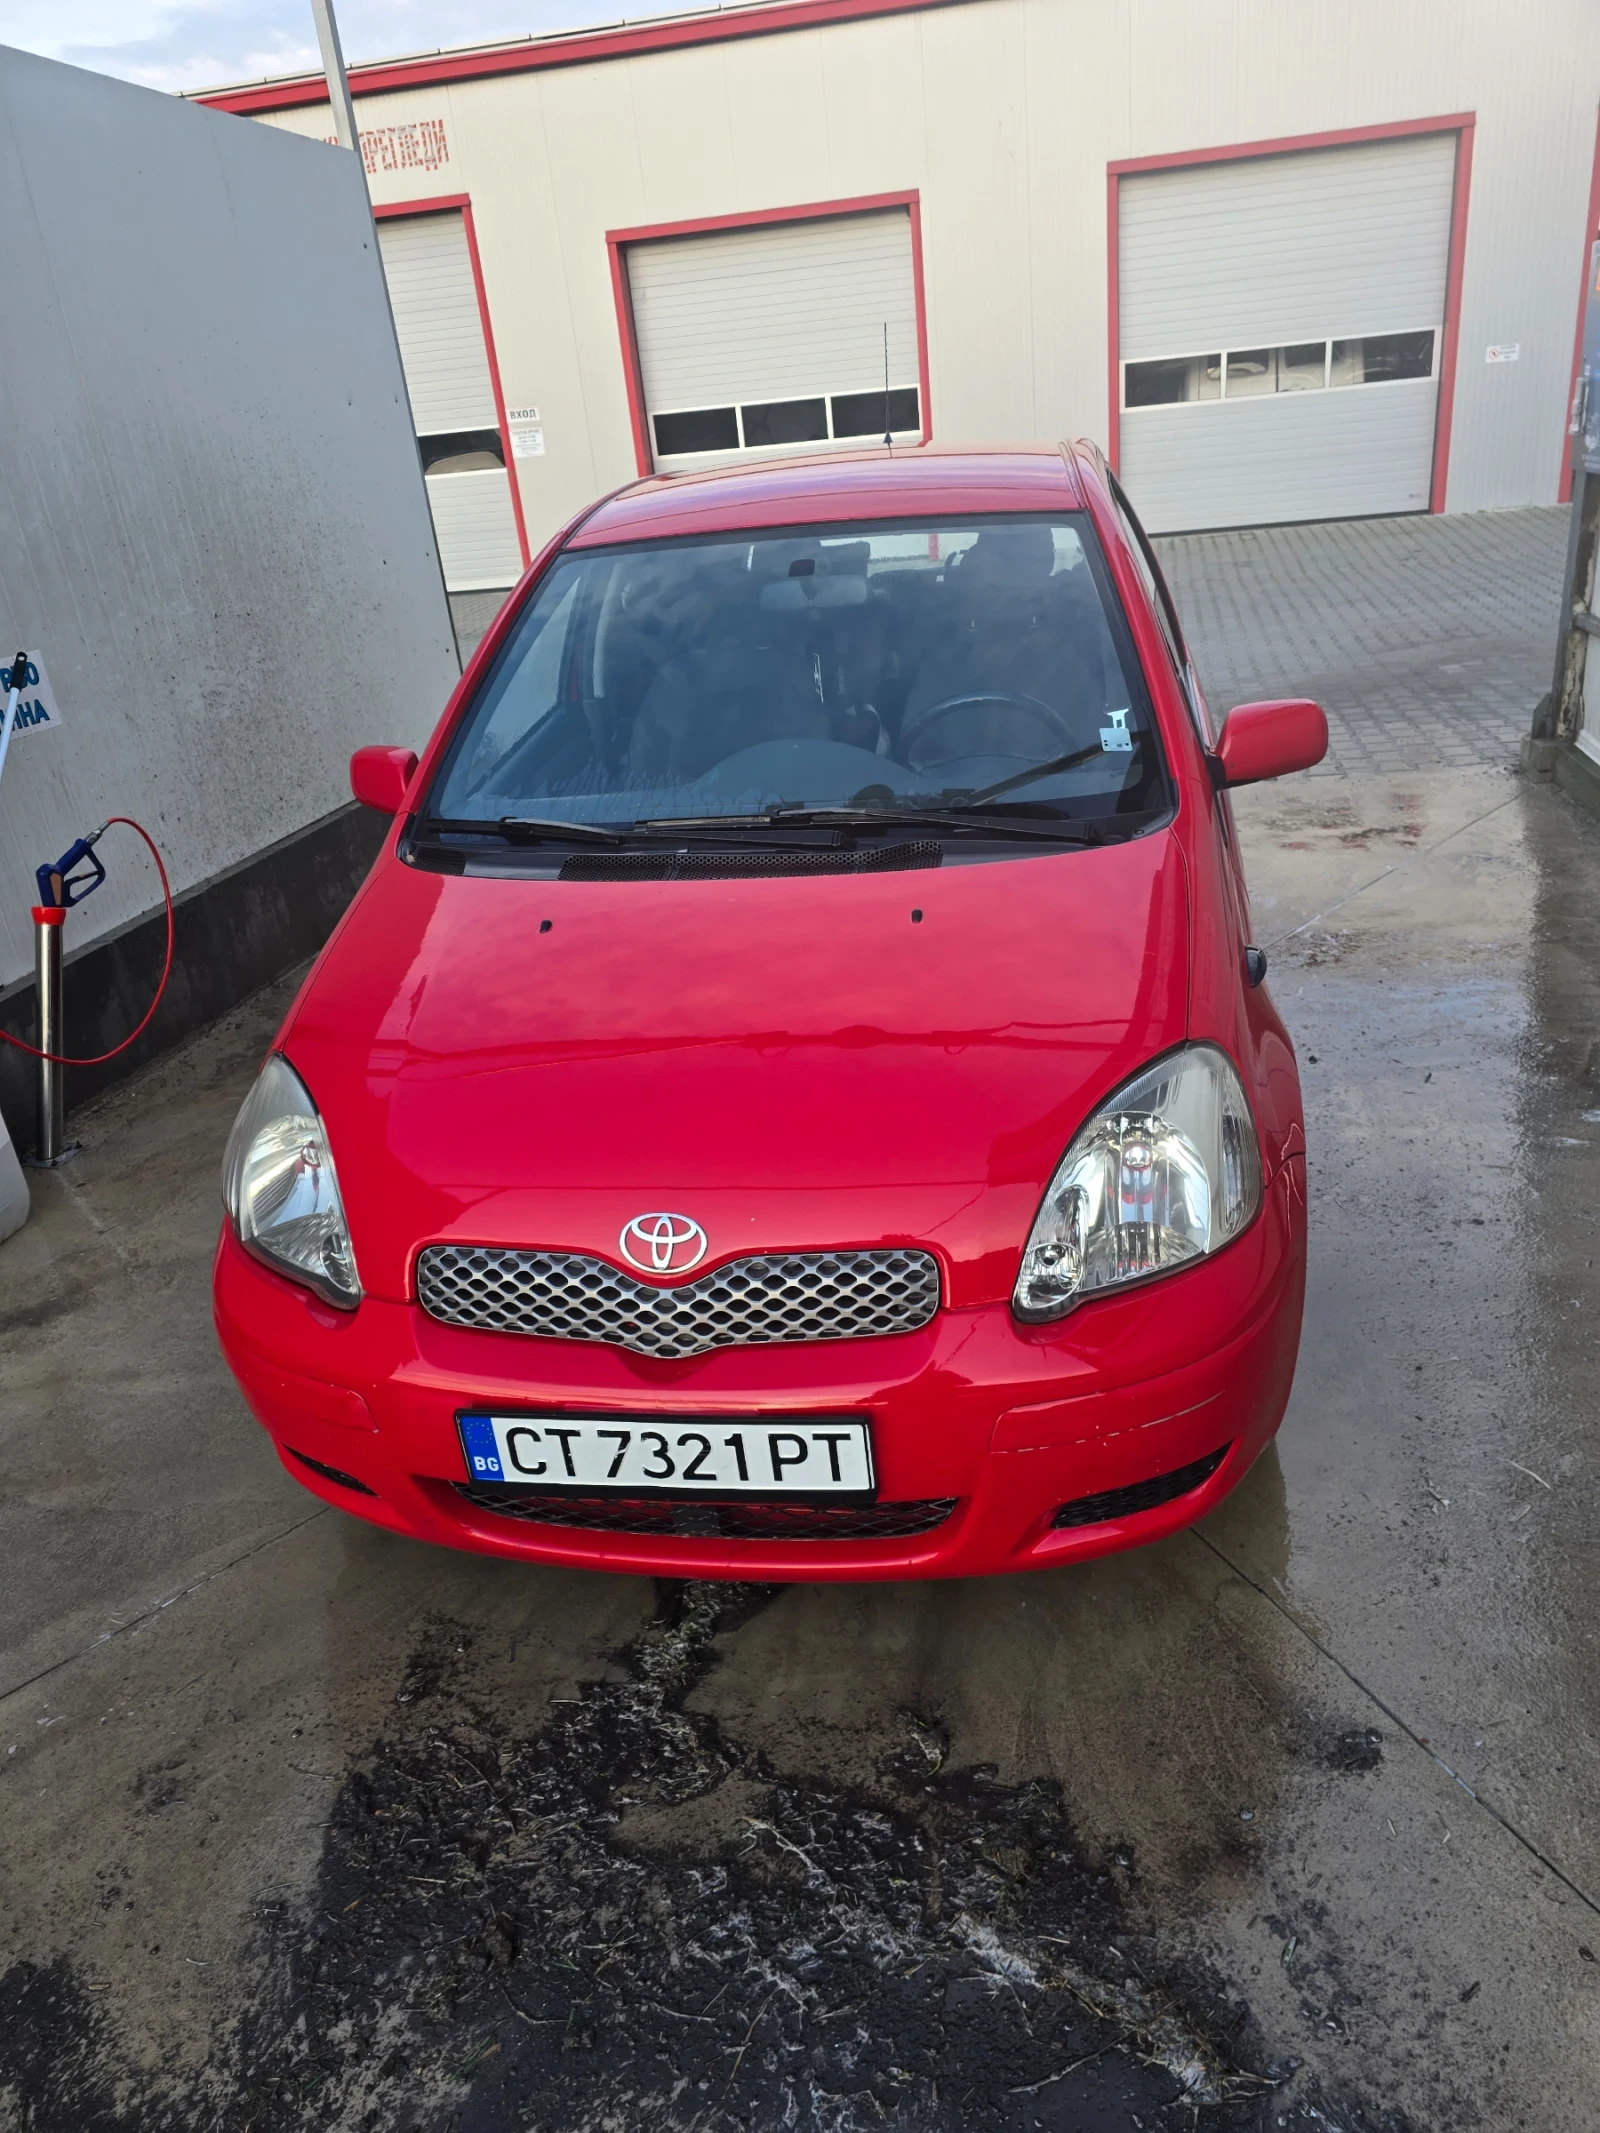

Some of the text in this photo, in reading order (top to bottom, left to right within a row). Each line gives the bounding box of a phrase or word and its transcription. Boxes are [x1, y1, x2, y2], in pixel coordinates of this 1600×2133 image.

[509, 409, 537, 420] ВХОД
[0, 661, 39, 693] РО
[473, 1456, 499, 1471] BG
[505, 1426, 852, 1482] CT 7321 PT
